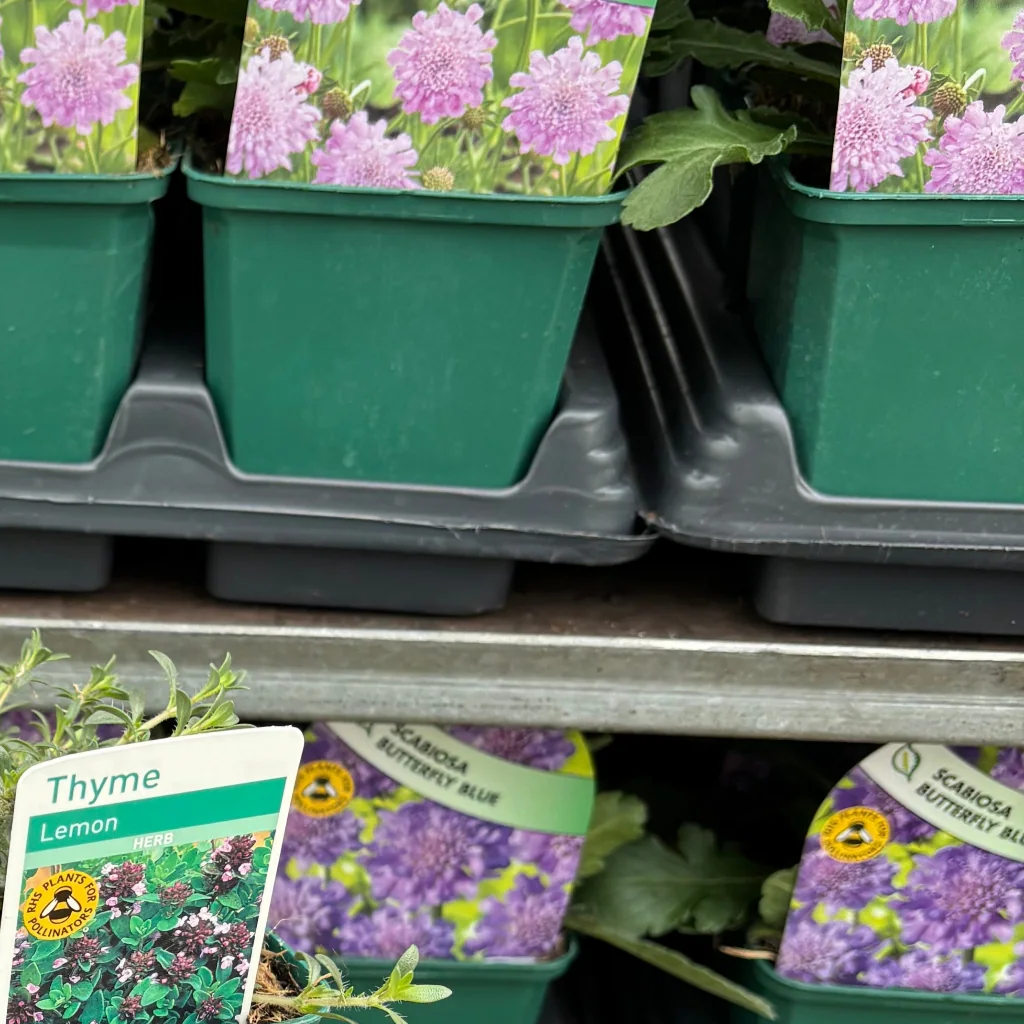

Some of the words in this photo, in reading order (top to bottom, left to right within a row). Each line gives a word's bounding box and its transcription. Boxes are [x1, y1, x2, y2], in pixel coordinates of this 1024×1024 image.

[390, 723, 468, 775] SCABIOSA
[47, 768, 161, 805] Thyme
[376, 736, 458, 789] BUTTERFLY
[458, 782, 500, 806] BLUE
[916, 782, 999, 833] BUTTERFLY
[932, 768, 1012, 819] SCABIOSA
[40, 816, 118, 843] Lemon
[132, 832, 175, 850] HERB
[27, 891, 42, 914] RHS
[42, 873, 87, 891] PLANTS
[84, 882, 97, 904] FOR
[27, 907, 93, 938] POLLINATORS
